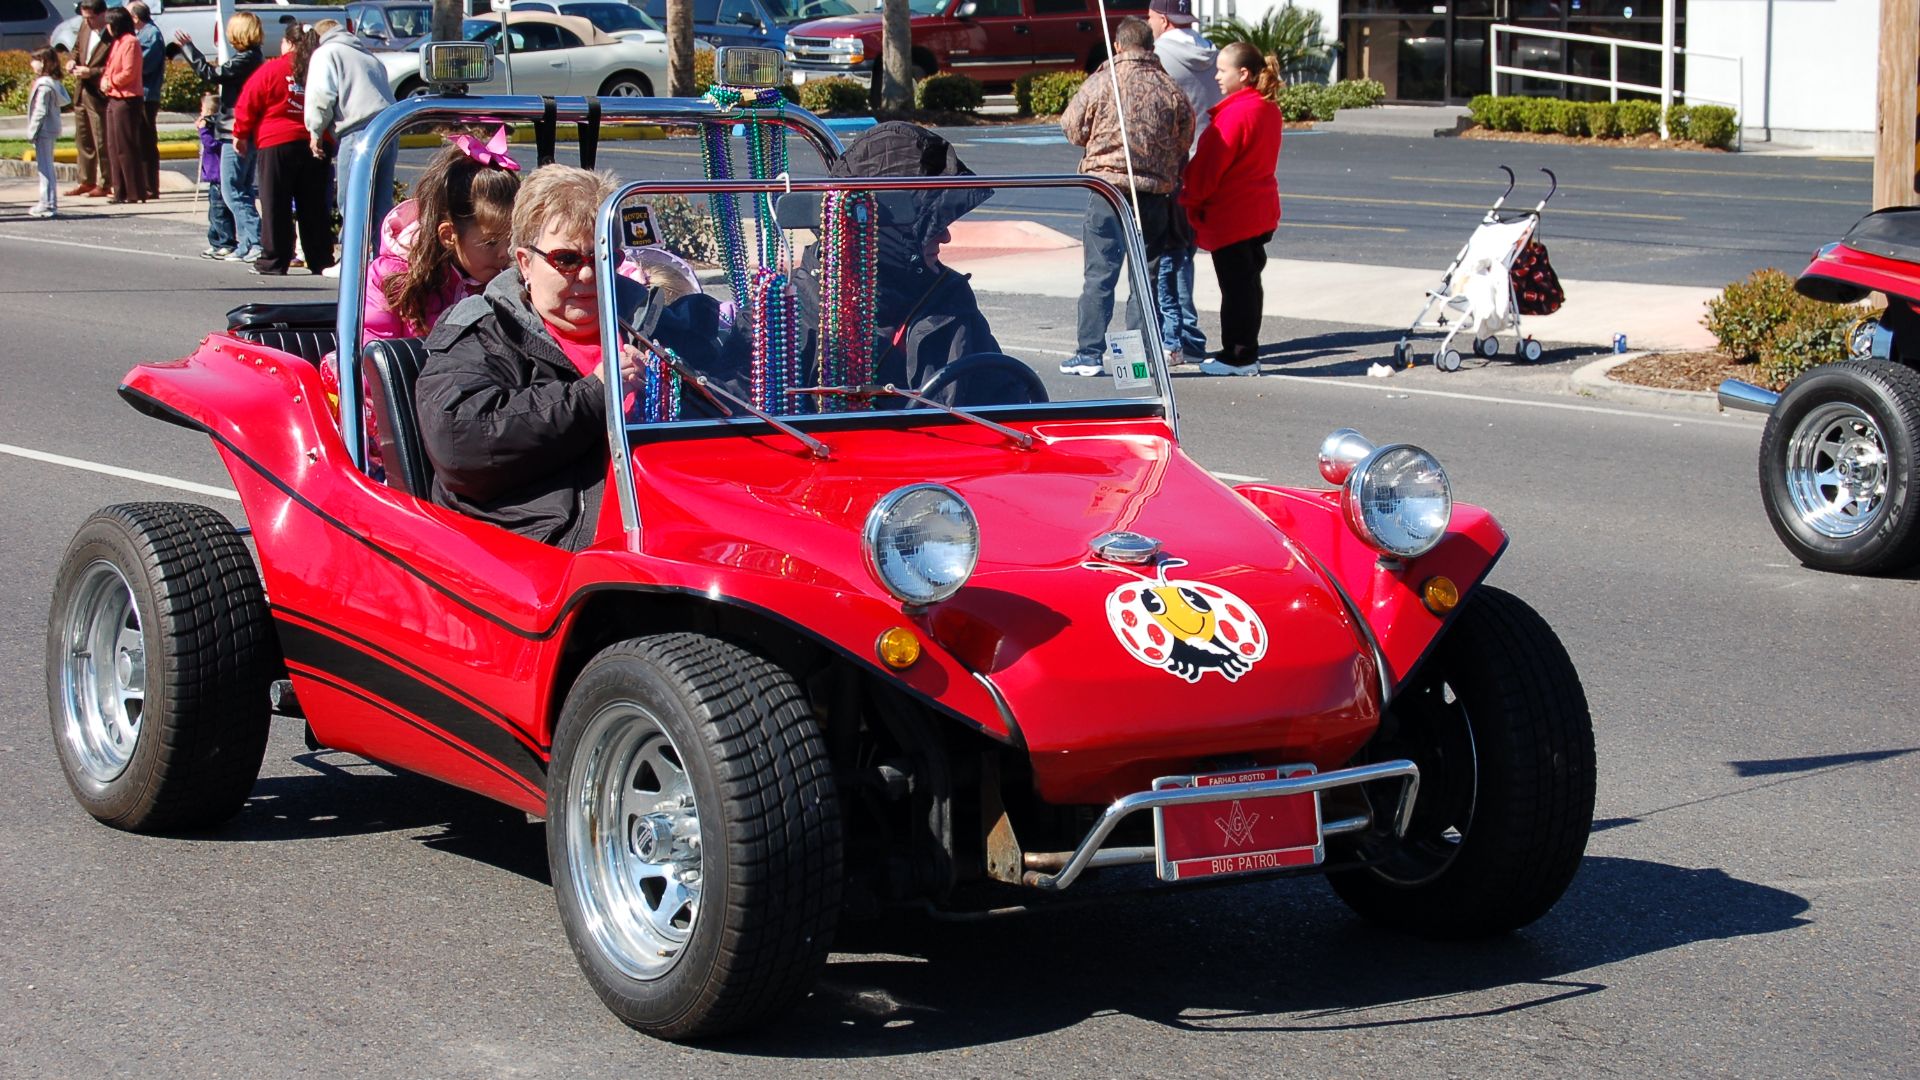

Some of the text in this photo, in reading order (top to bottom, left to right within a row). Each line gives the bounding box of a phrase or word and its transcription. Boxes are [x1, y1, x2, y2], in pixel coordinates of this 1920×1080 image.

[1116, 364, 1146, 379] 01 07
[1209, 772, 1266, 787] FARHAD GROTTO
[1233, 815, 1243, 832] G
[1211, 853, 1281, 874] BUG PATROL
